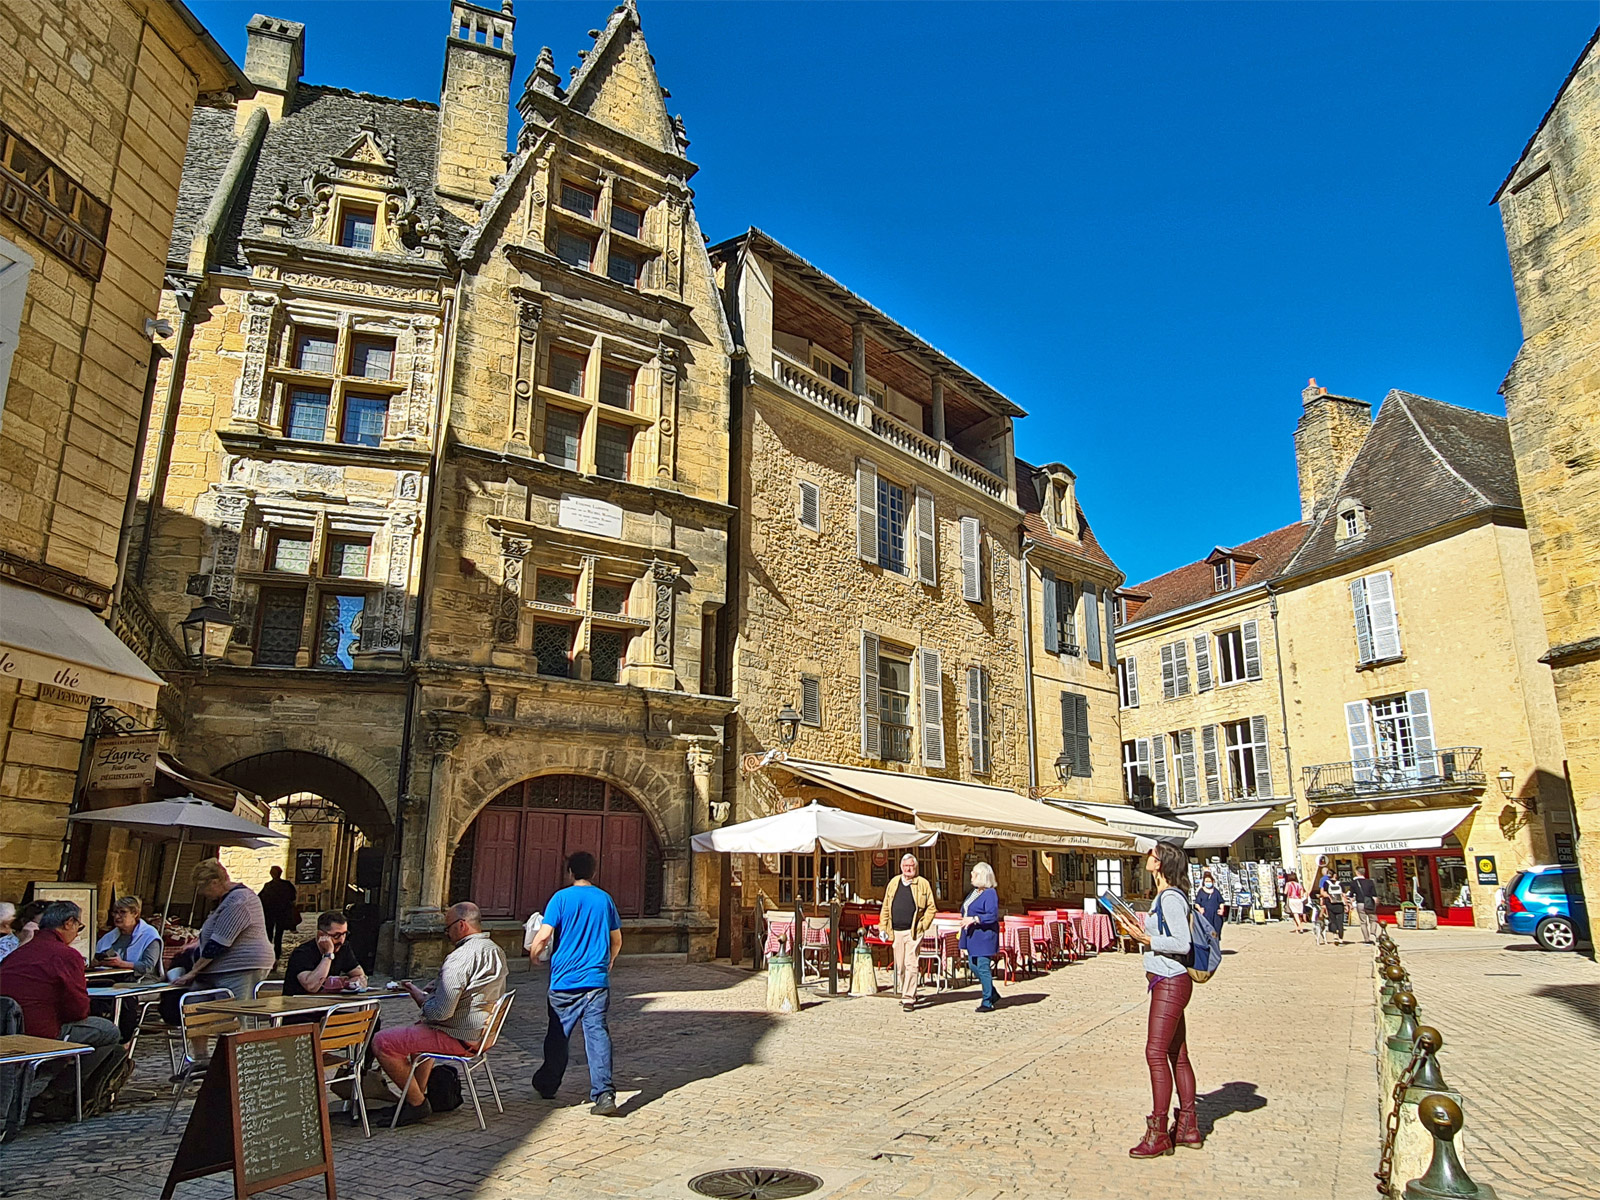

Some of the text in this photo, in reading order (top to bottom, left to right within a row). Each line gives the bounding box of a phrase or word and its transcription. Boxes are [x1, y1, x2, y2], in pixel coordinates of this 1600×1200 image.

[2, 183, 91, 268] DETAIL
[53, 668, 80, 687] thé
[97, 747, 151, 766] Lagrèze
[1345, 844, 1365, 852] GRAS
